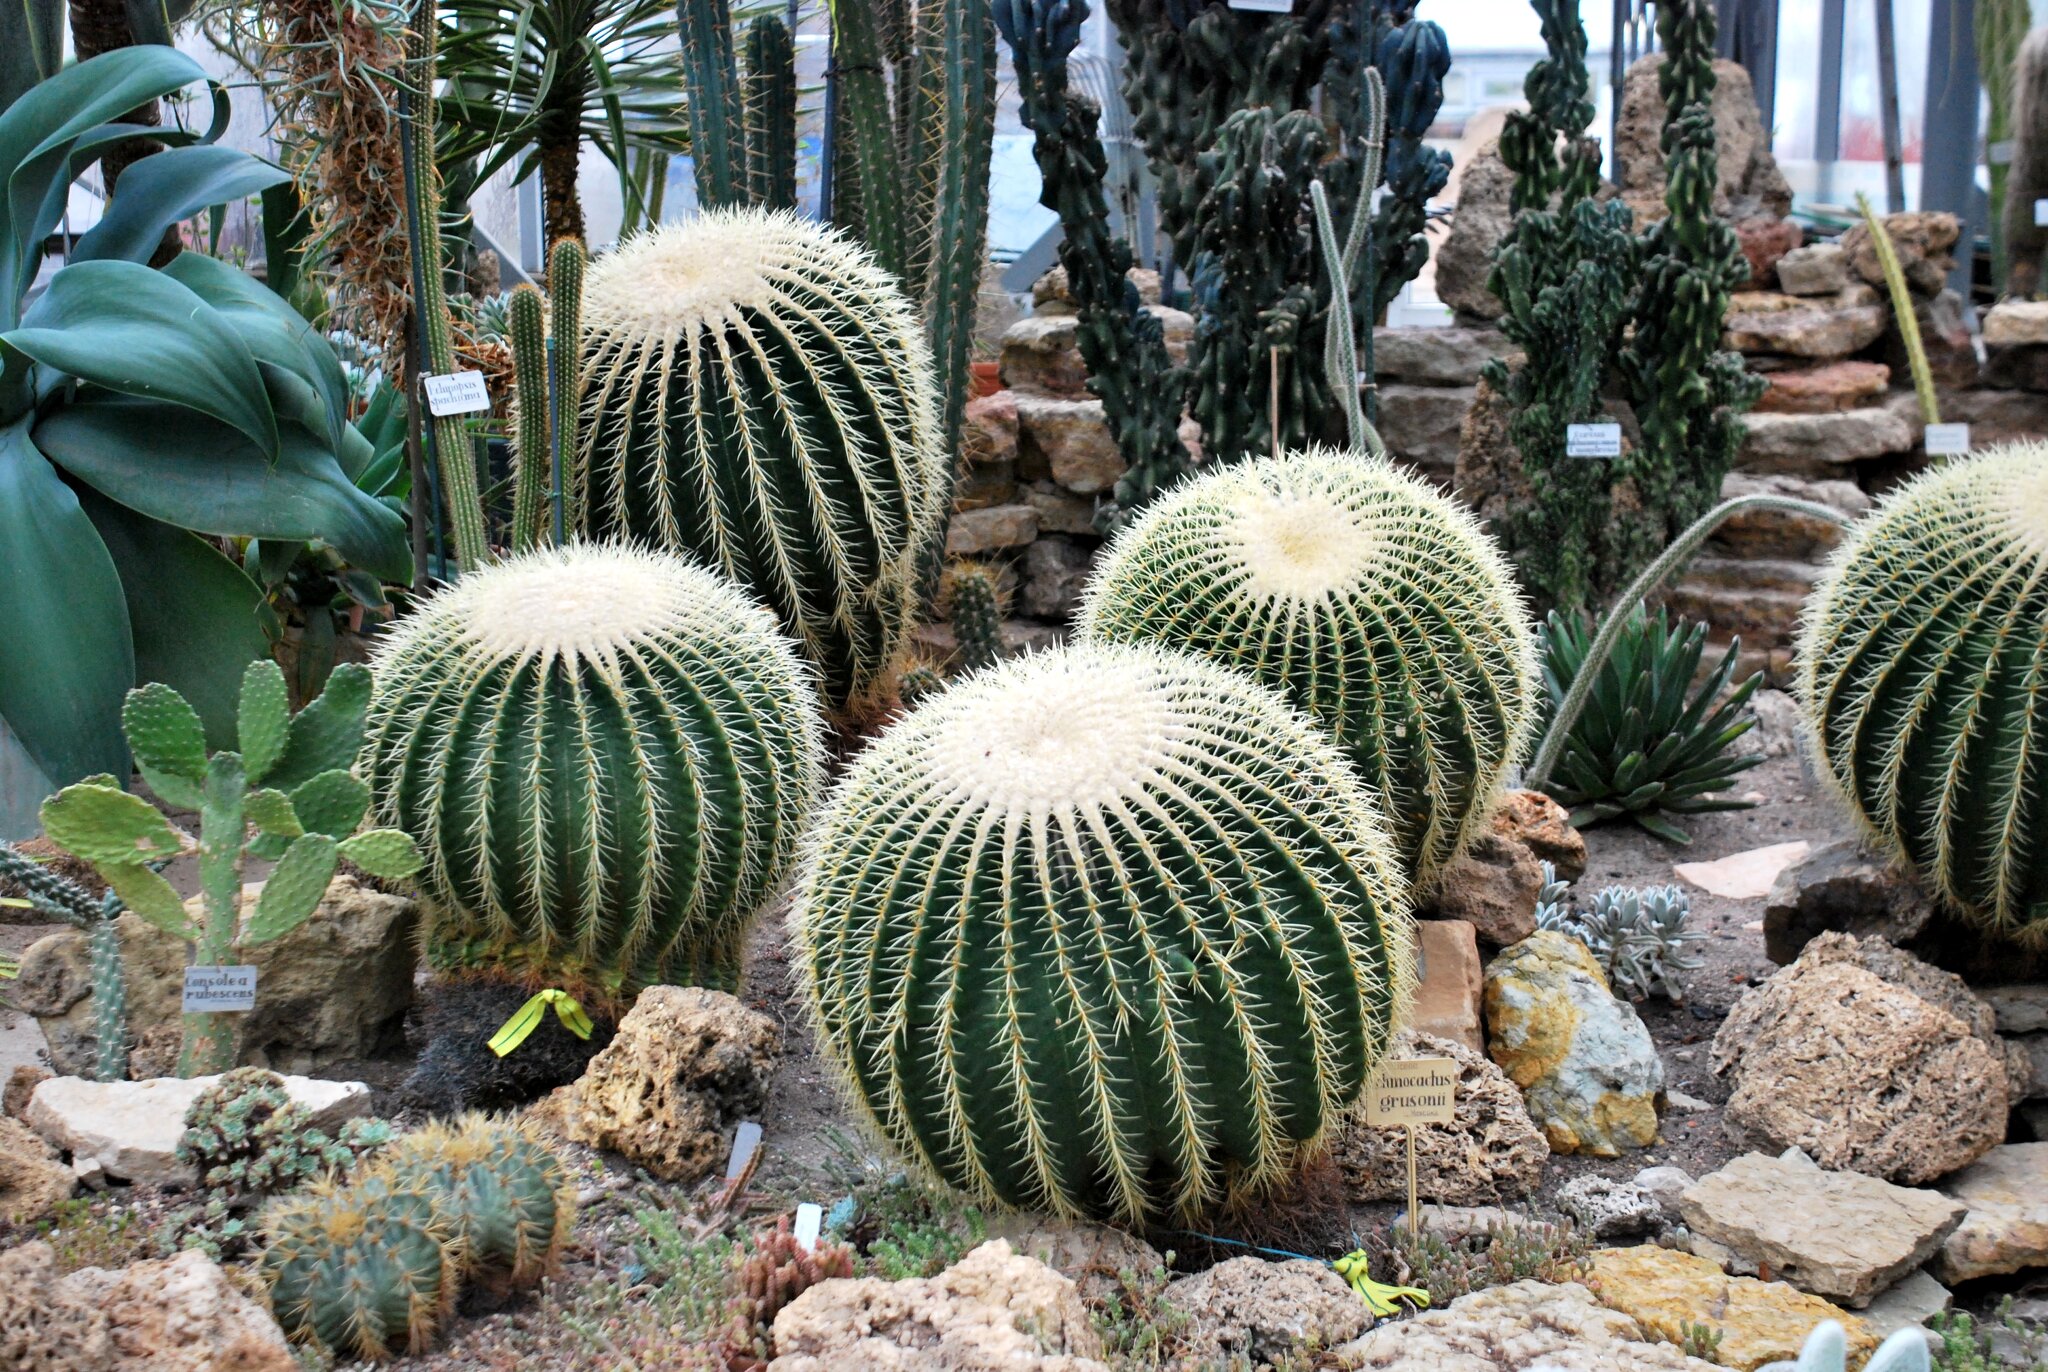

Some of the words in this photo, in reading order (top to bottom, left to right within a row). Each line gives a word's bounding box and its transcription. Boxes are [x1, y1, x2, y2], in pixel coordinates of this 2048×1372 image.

[185, 973, 248, 987] Consolea
[185, 985, 254, 999] rubescens
[1380, 1092, 1446, 1113] grusonii
